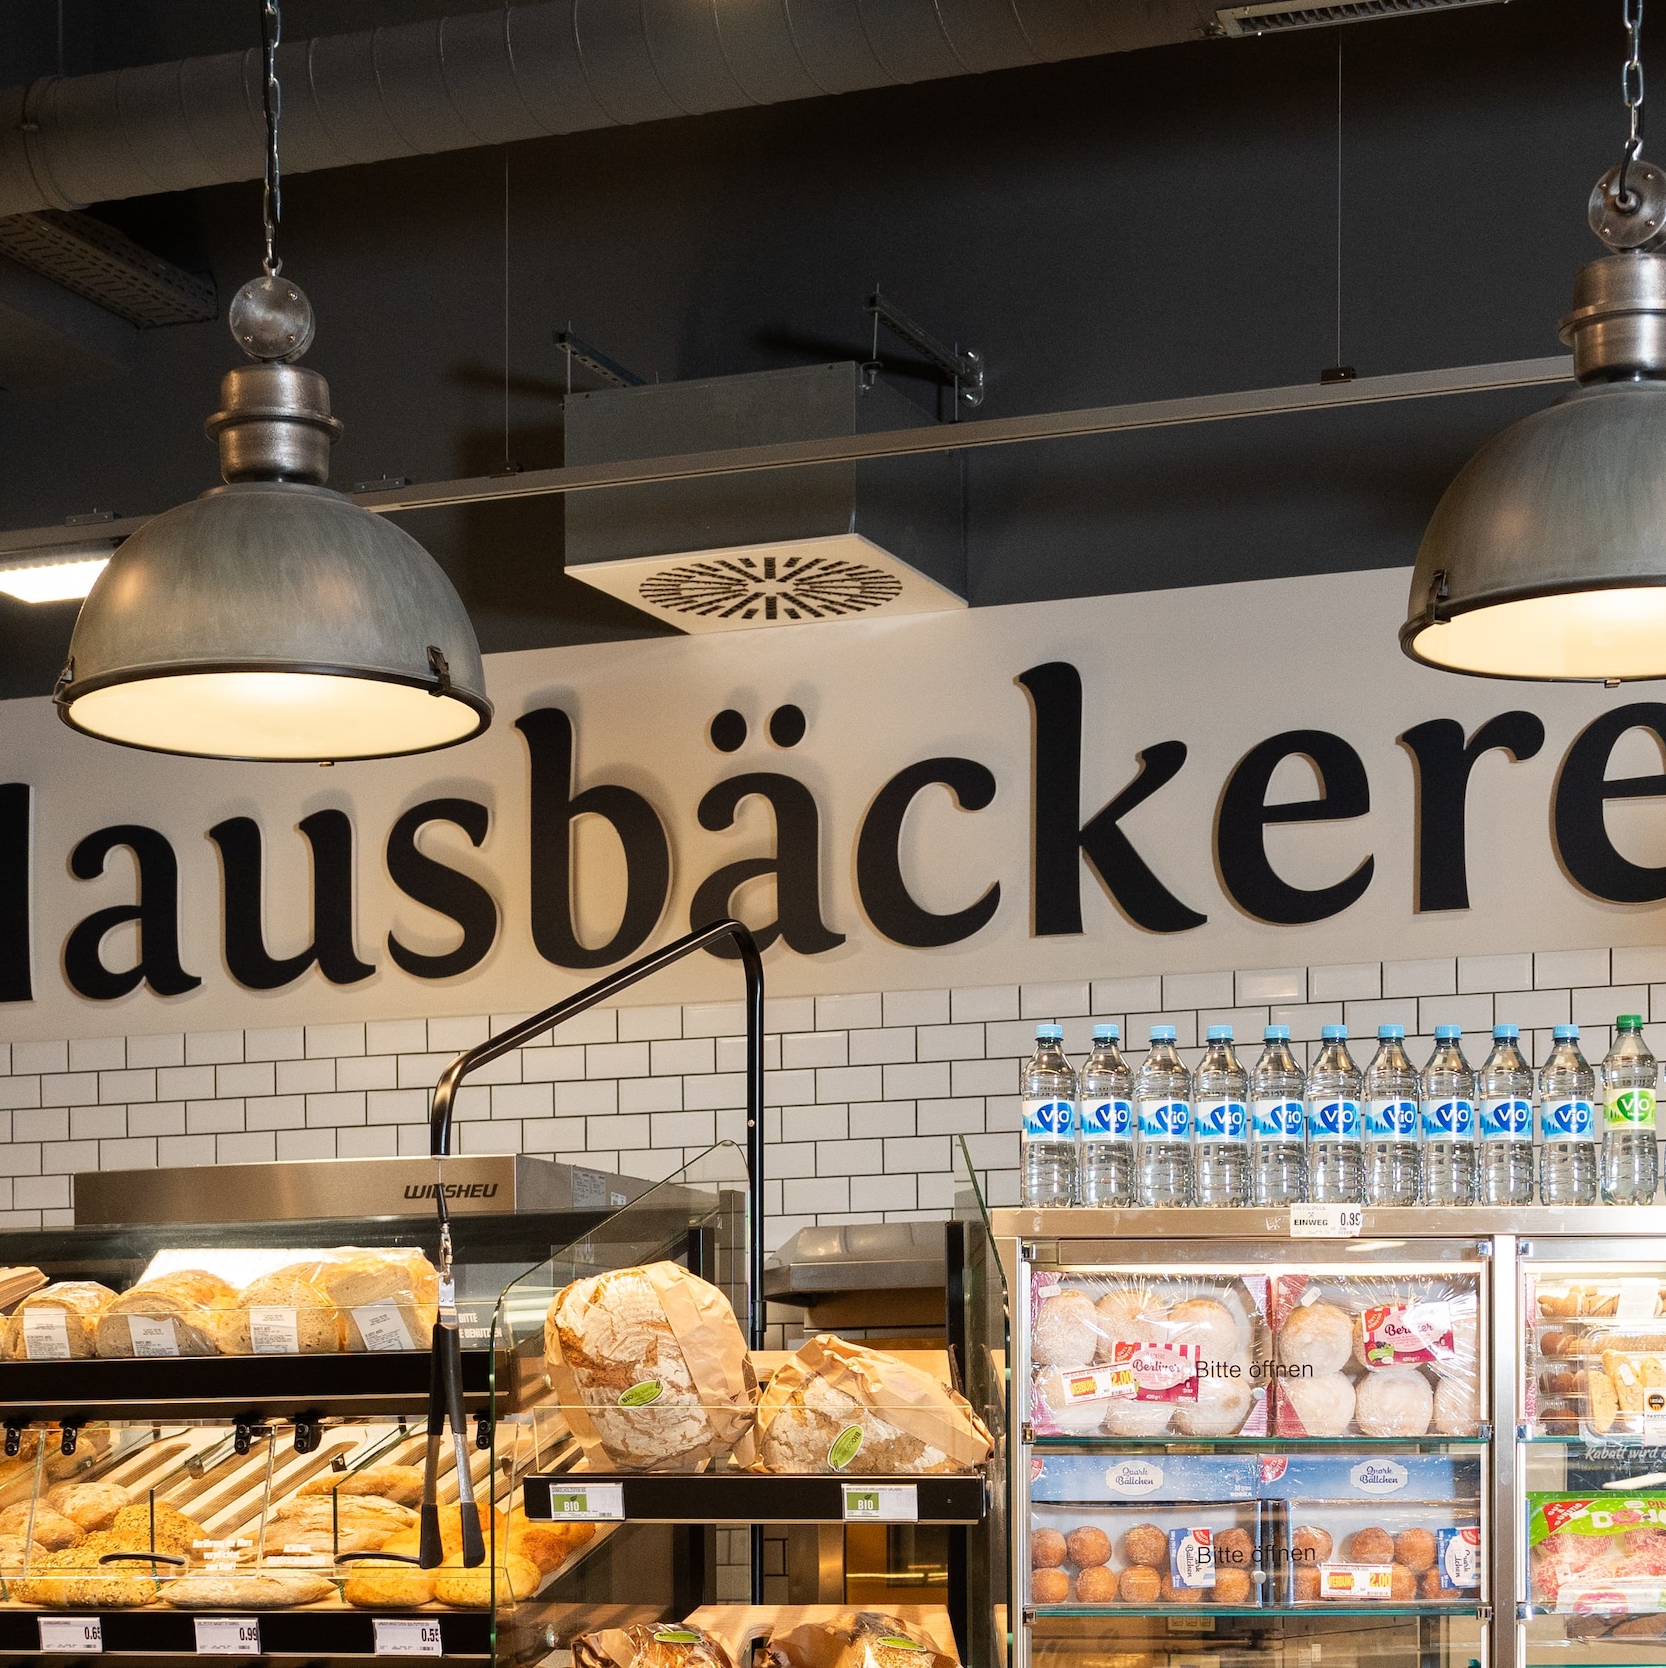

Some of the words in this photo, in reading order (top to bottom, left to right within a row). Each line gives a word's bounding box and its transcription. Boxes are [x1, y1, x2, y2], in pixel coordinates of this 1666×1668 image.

[1293, 1218, 1328, 1227] EINWEG
[459, 1313, 478, 1323] BITTE
[1195, 1360, 1241, 1378] Bitte
[1249, 1359, 1313, 1378] öffnen
[1115, 1475, 1154, 1485] Bällchen
[1359, 1475, 1398, 1485] Bällchen
[564, 1501, 580, 1512] BIO
[857, 1499, 874, 1510] BIO
[1198, 1546, 1244, 1563] Bitte
[1252, 1544, 1315, 1563] öffnen
[1369, 1573, 1391, 1586] 2.00
[237, 1626, 257, 1642] 0.99
